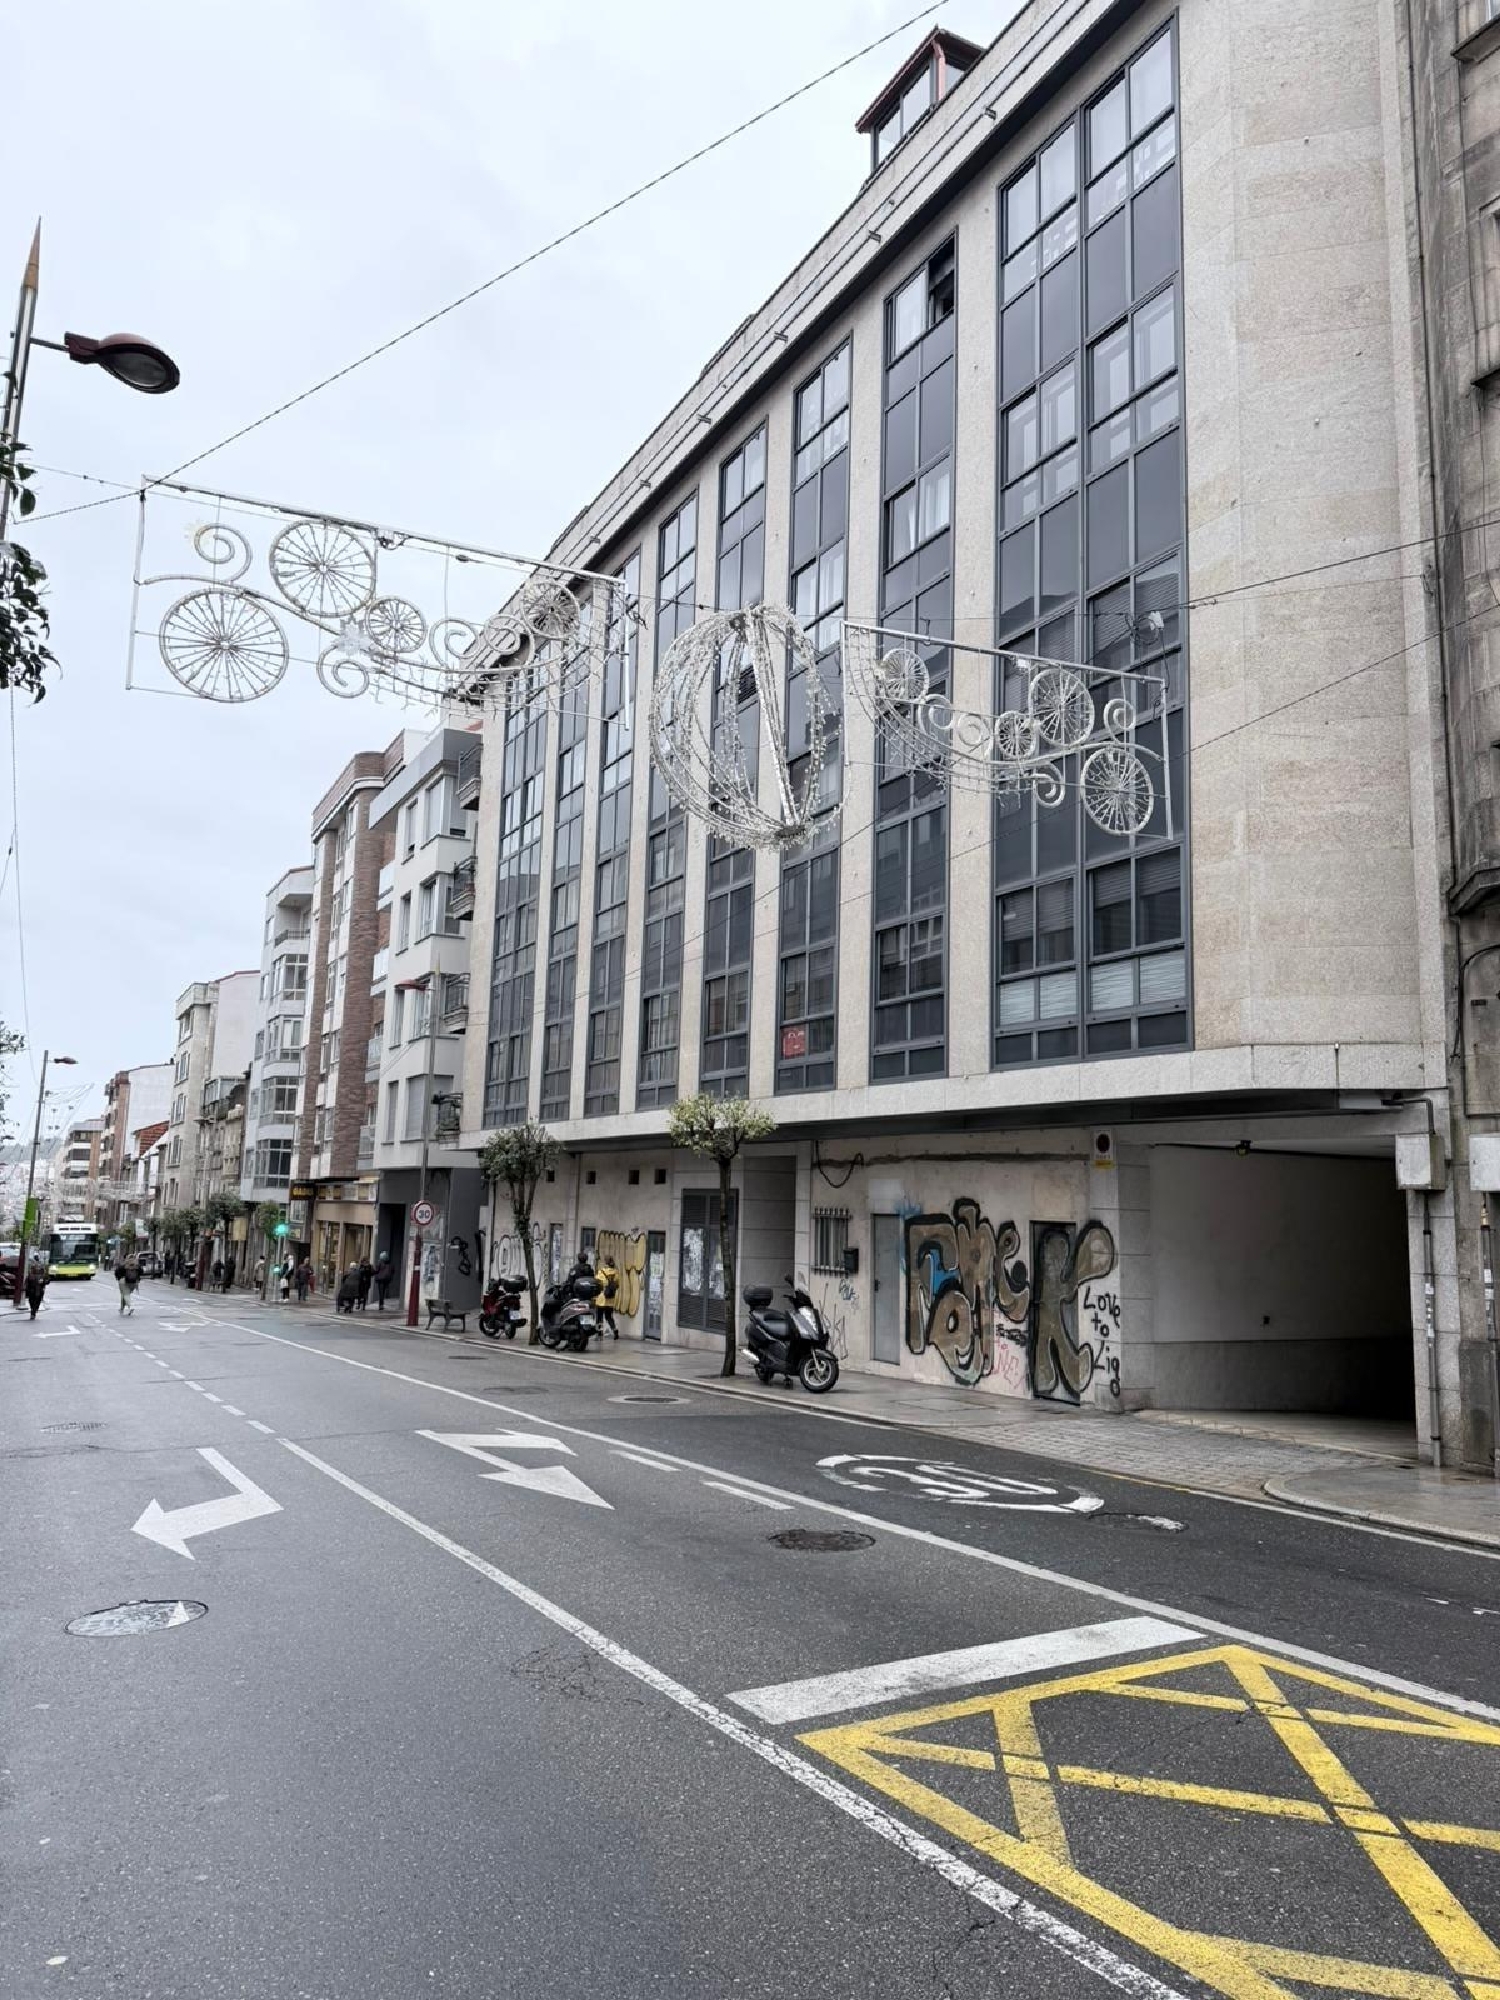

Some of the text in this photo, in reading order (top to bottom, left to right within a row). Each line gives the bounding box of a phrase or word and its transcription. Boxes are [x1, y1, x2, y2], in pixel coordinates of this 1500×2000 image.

[418, 1209, 431, 1219] 30
[1083, 1286, 1121, 1329] Love
[1091, 1311, 1110, 1338] to
[849, 1464, 1059, 1498] 30
